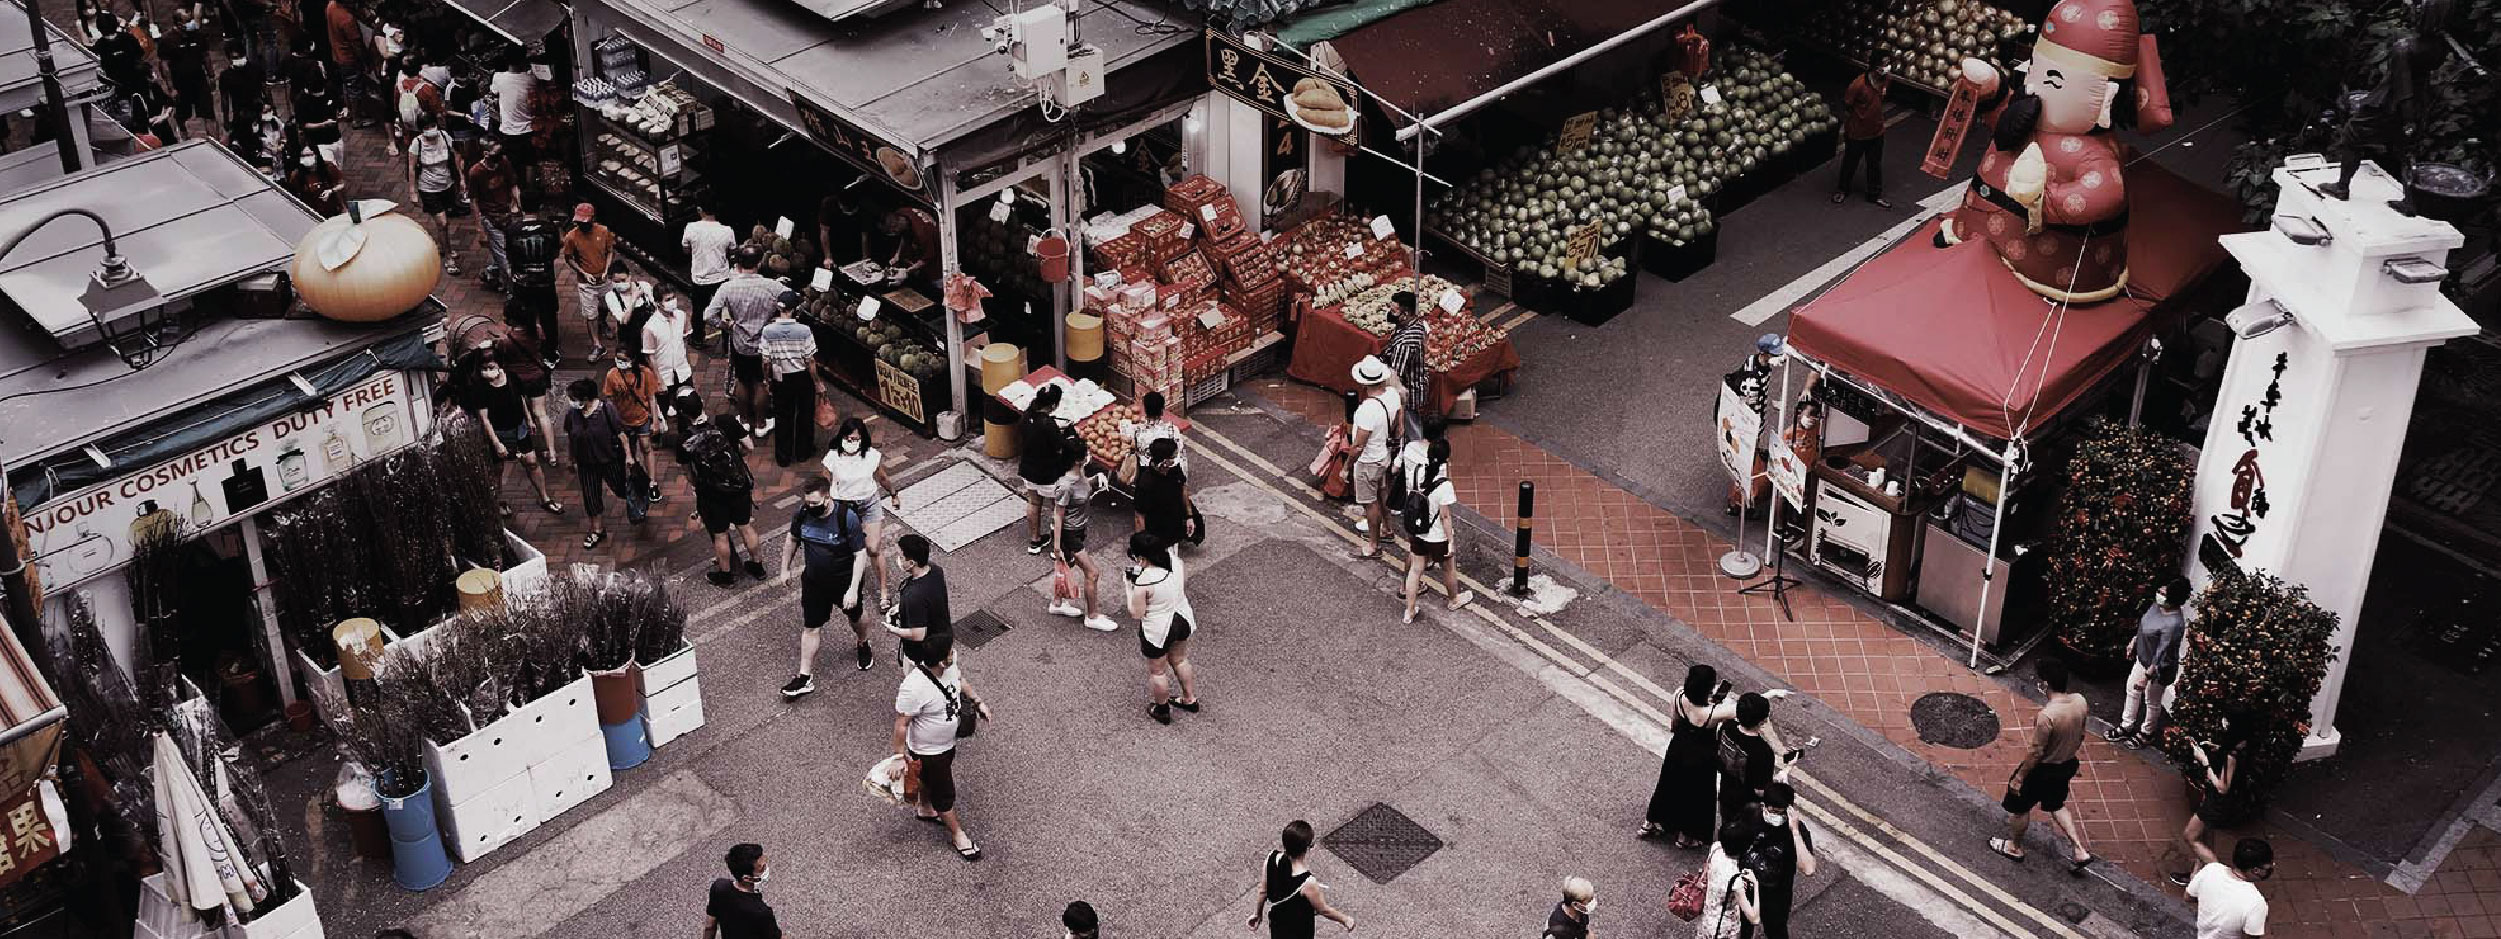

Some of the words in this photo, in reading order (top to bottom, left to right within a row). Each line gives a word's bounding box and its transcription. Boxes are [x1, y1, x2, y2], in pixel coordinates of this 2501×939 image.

[1217, 49, 1287, 104] 黑金
[120, 432, 260, 499] COSMETICS
[272, 400, 334, 440] DUTY
[343, 378, 395, 412] FREE
